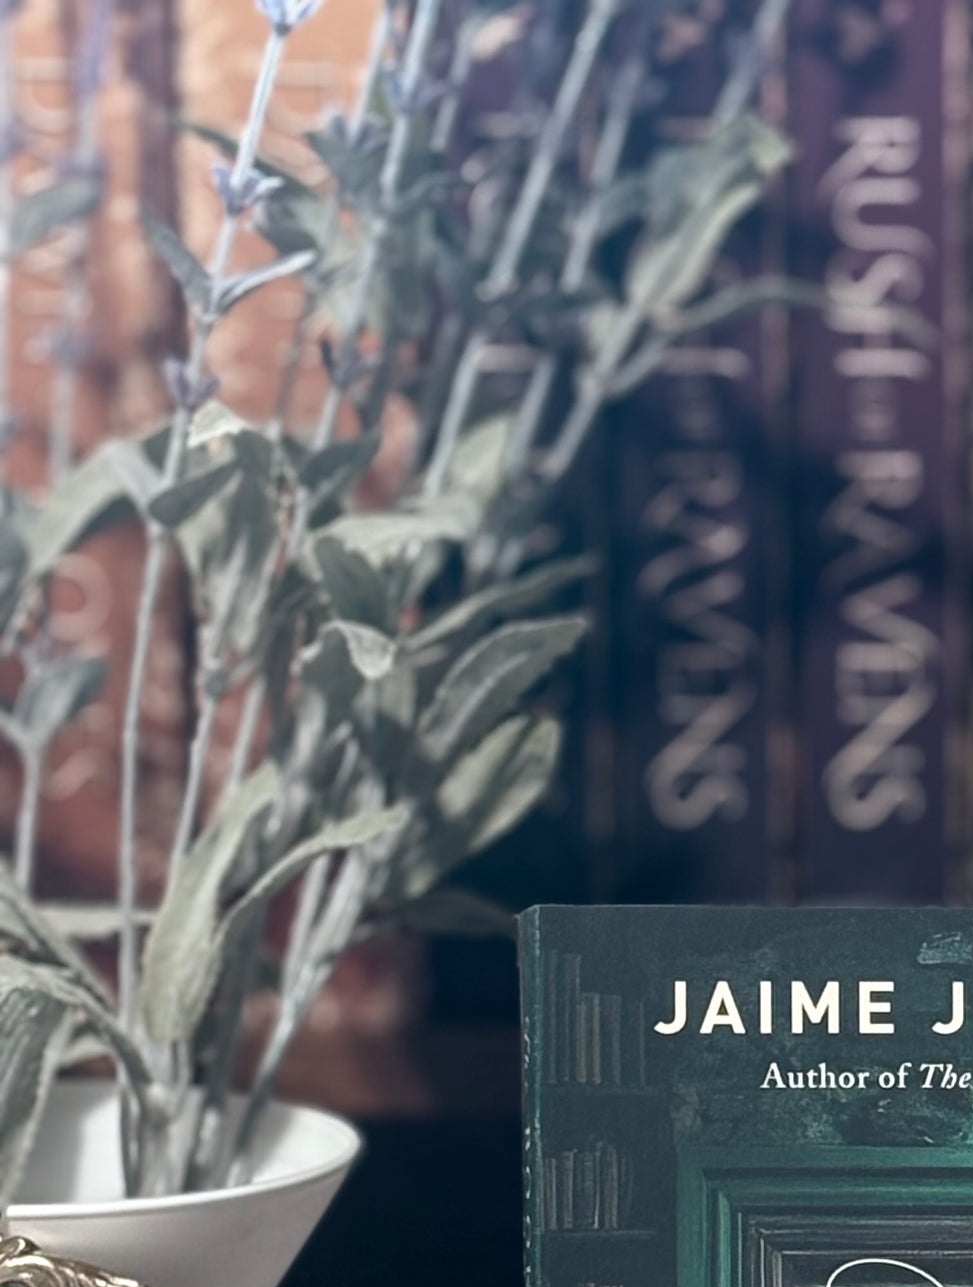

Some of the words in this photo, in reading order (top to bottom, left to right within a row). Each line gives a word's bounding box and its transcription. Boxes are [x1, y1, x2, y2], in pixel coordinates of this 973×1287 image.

[818, 115, 937, 380] RUSH
[653, 980, 896, 1035] JAIME
[760, 1061, 871, 1090] Author
[877, 1061, 913, 1089] of
[919, 1062, 973, 1090] The
